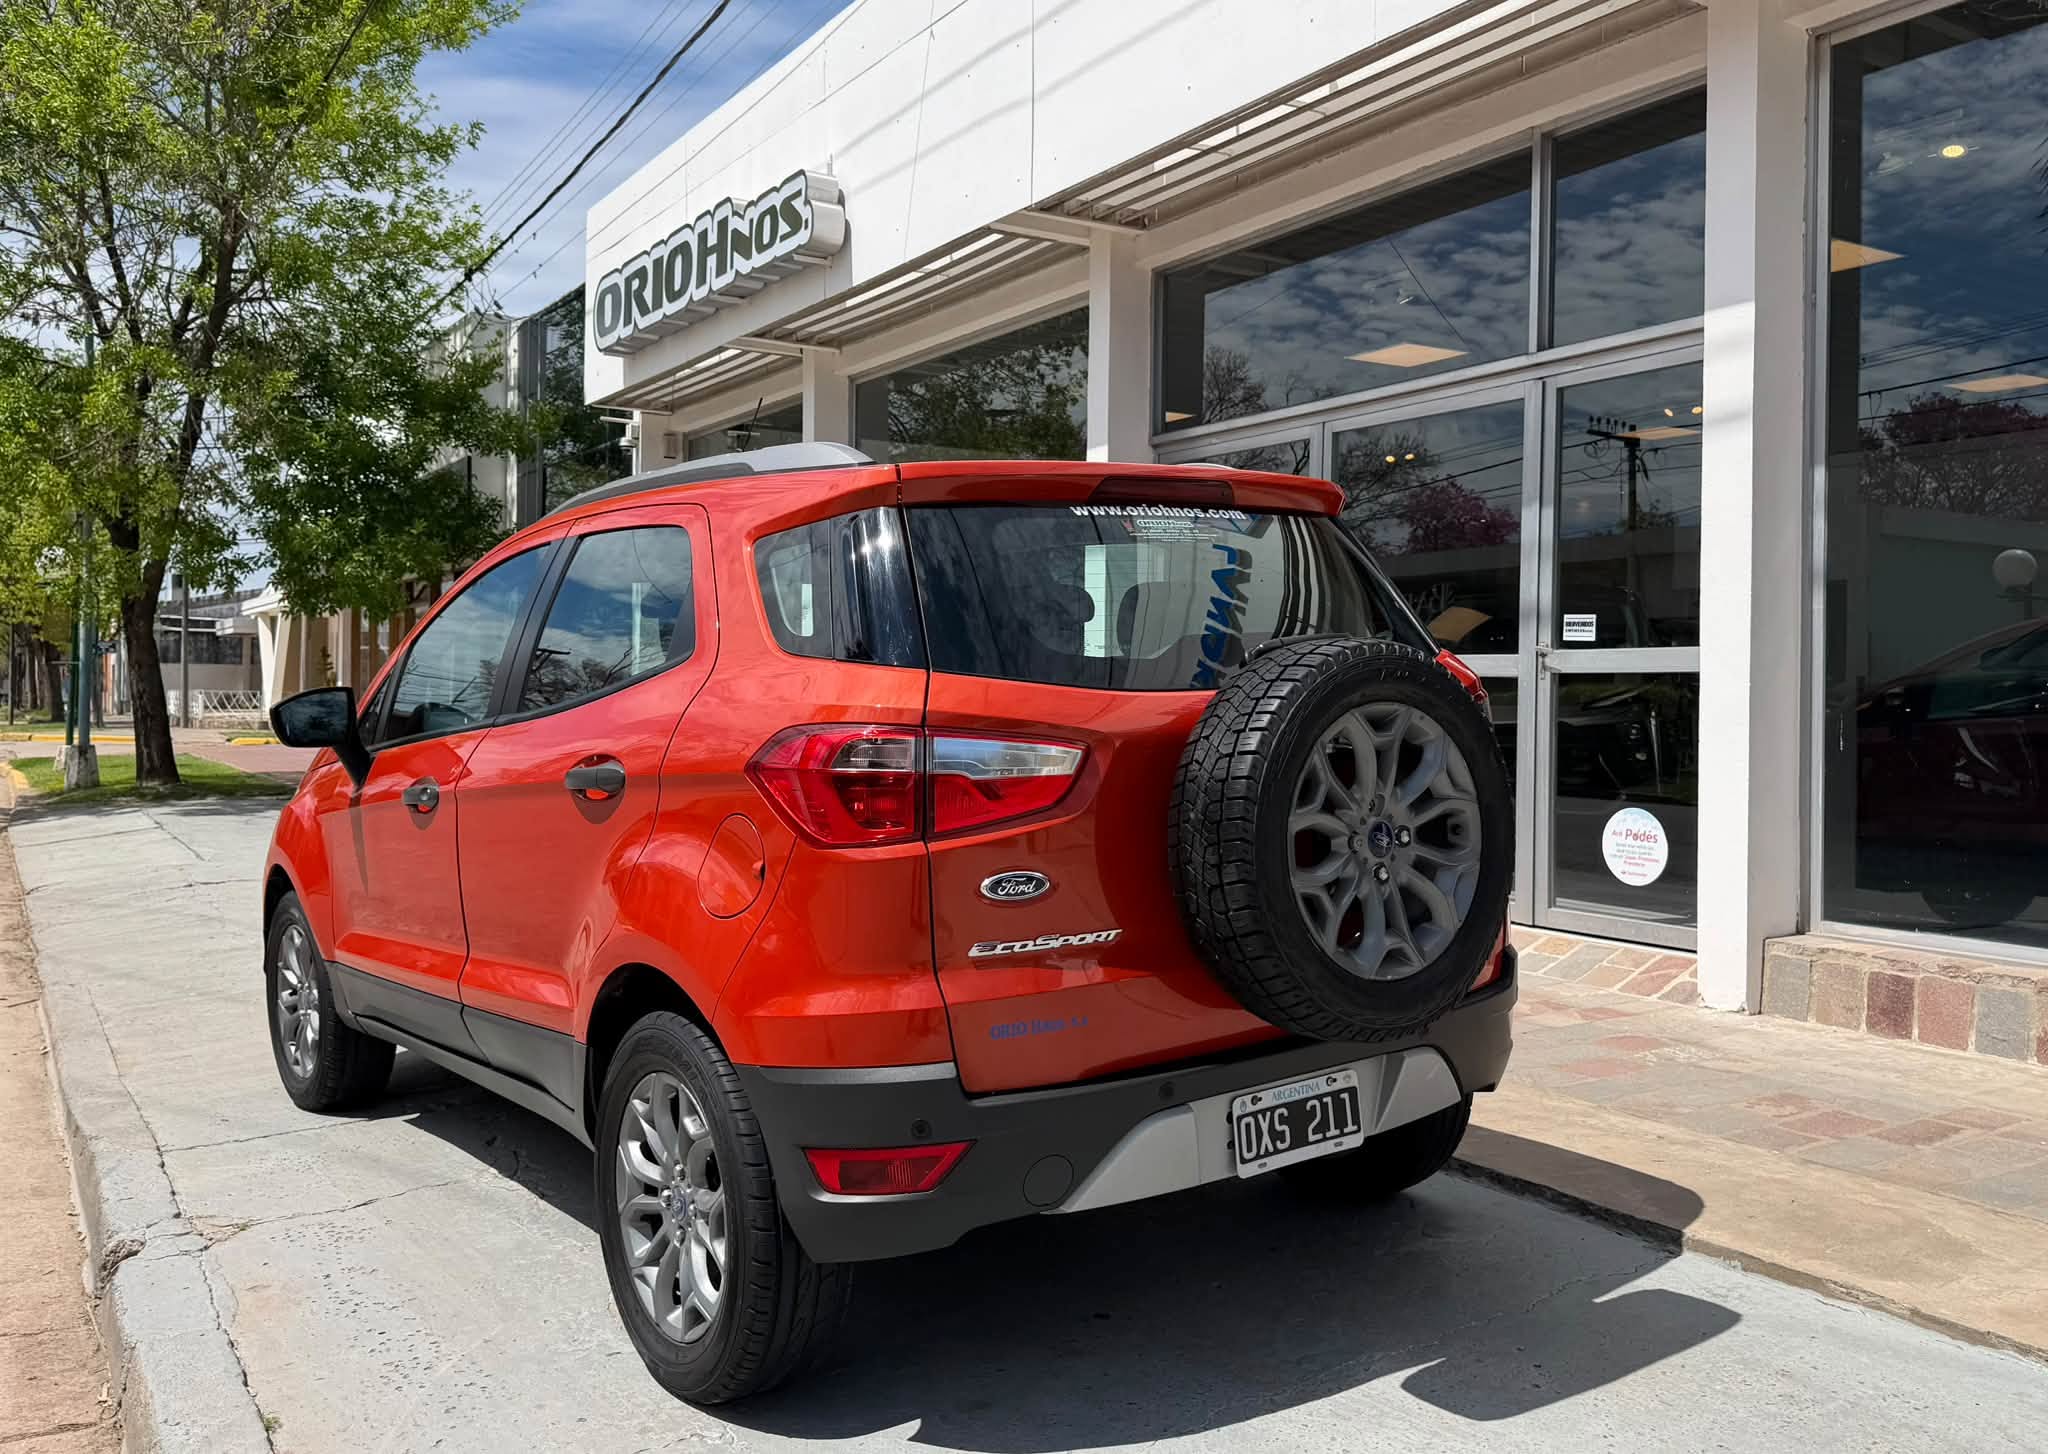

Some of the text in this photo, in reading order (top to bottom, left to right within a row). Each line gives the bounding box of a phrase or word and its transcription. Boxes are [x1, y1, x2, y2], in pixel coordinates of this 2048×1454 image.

[1069, 504, 1248, 521] www.oriohnos.com
[1625, 828, 1659, 844] Podés
[997, 877, 1036, 895] Ford
[1271, 1081, 1320, 1103] ARGENTINA
[1239, 1092, 1358, 1161] OXS 211
